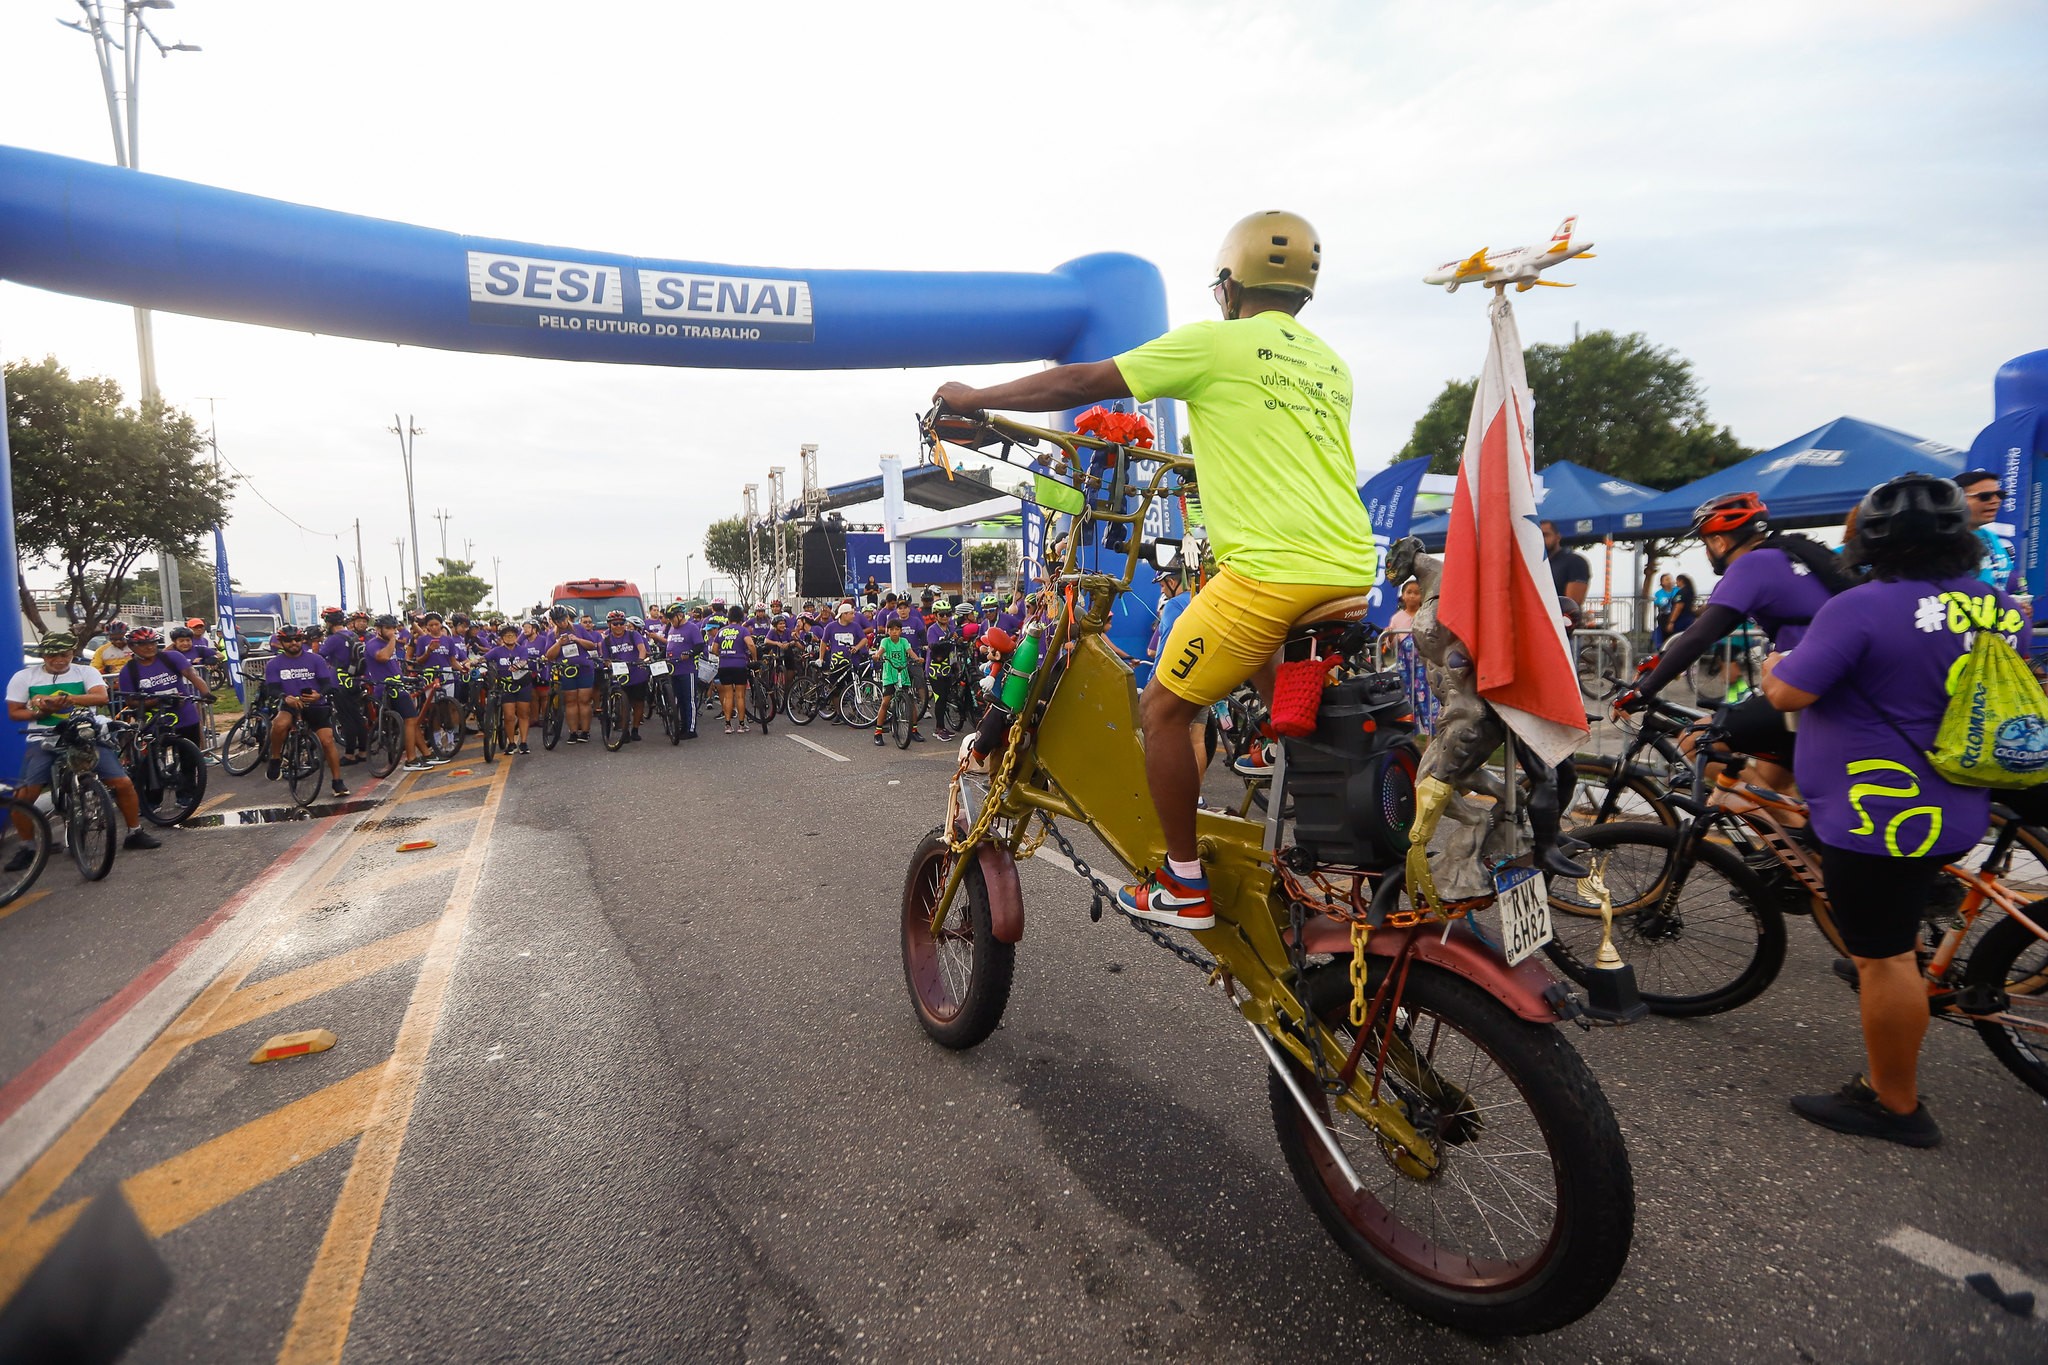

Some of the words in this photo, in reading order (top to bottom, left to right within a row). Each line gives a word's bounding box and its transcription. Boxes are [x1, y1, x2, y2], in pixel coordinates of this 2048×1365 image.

[485, 260, 607, 305] SESI
[654, 277, 797, 316] SENAI
[539, 314, 581, 330] PELO
[586, 318, 650, 335] FUTURO
[655, 322, 679, 337] DO
[682, 324, 761, 341] TRABALHO
[1375, 505, 1386, 527] Social
[1387, 485, 1403, 517] Indústria
[1163, 511, 1171, 533] PELO
[868, 554, 891, 564] SES
[1914, 591, 2024, 634] #Bike
[721, 640, 734, 650] ON
[1511, 877, 1540, 920] RWK
[1513, 907, 1547, 955] 6H82
